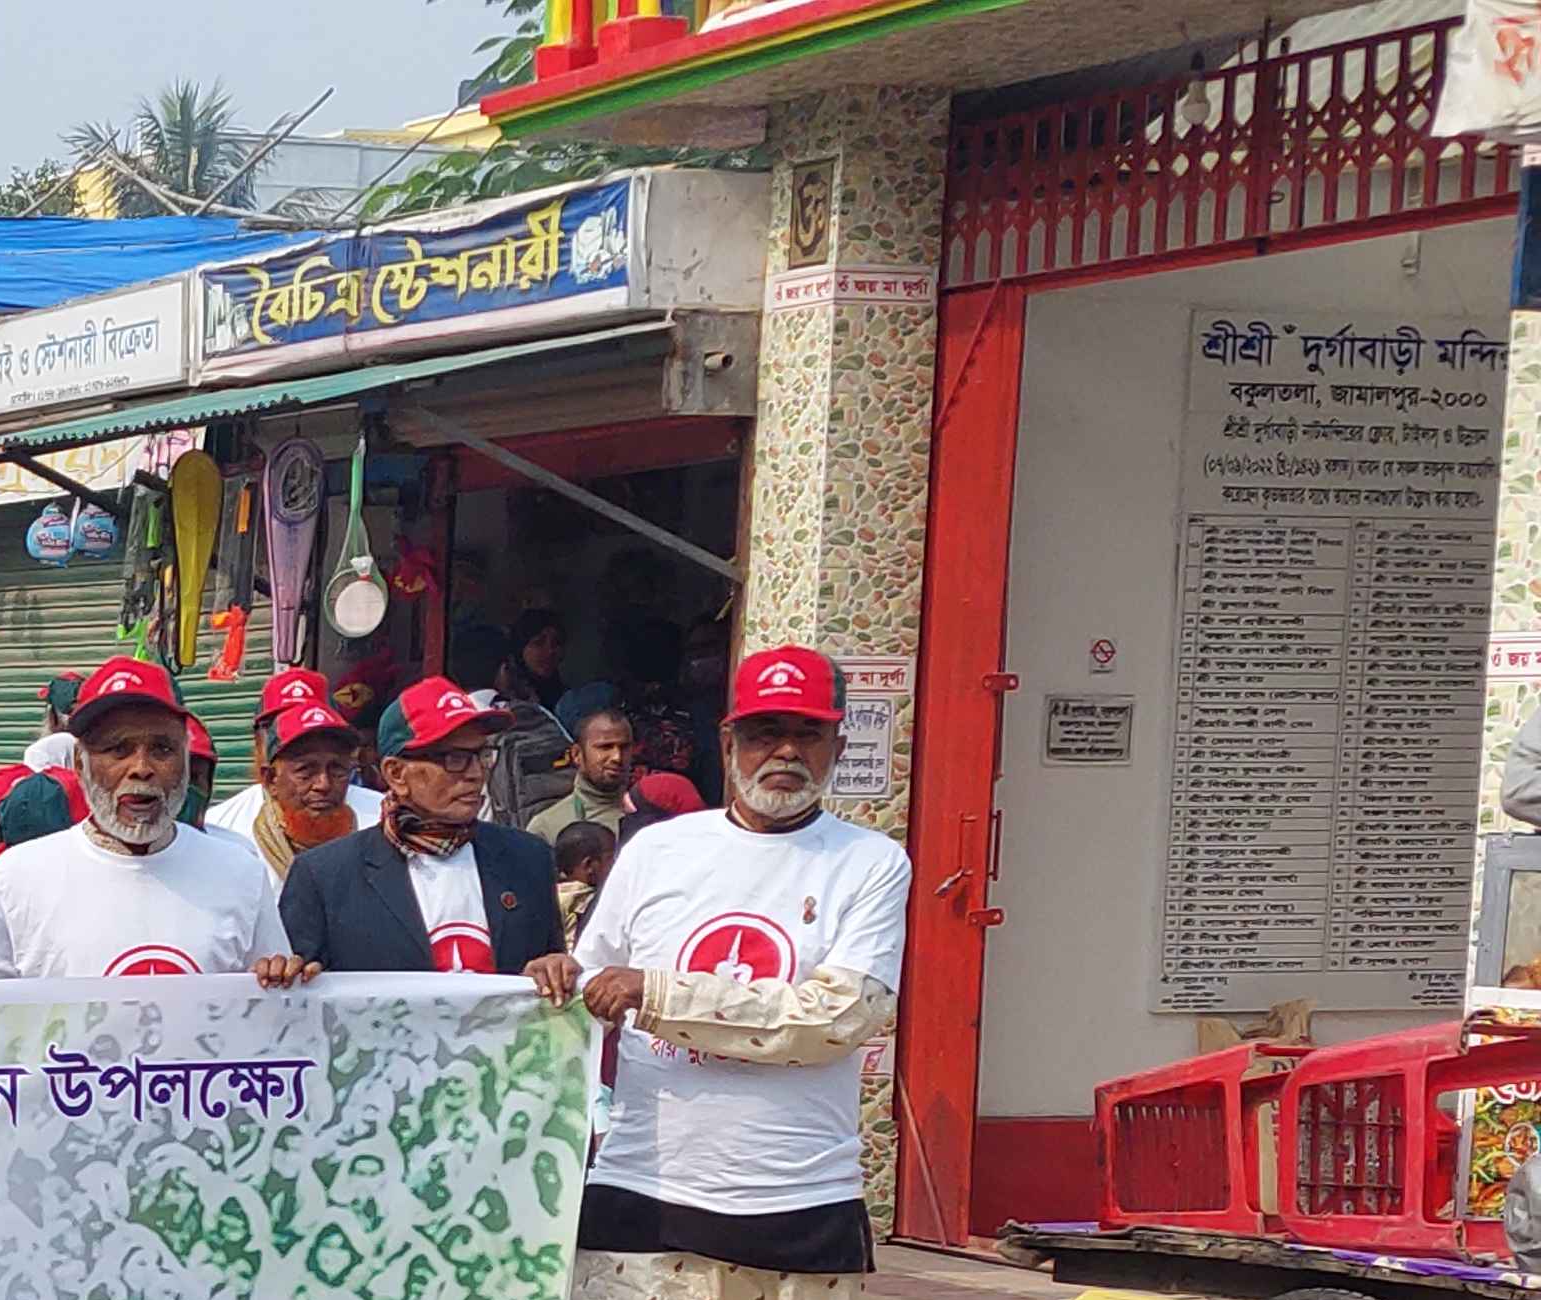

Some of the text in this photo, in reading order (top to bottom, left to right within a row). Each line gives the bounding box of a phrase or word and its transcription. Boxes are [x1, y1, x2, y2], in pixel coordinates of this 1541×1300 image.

[372, 199, 565, 324] স্টেশনারী
[1435, 329, 1511, 371] মন্দি
[42, 1044, 317, 1125] উপলক্ষ্যে
